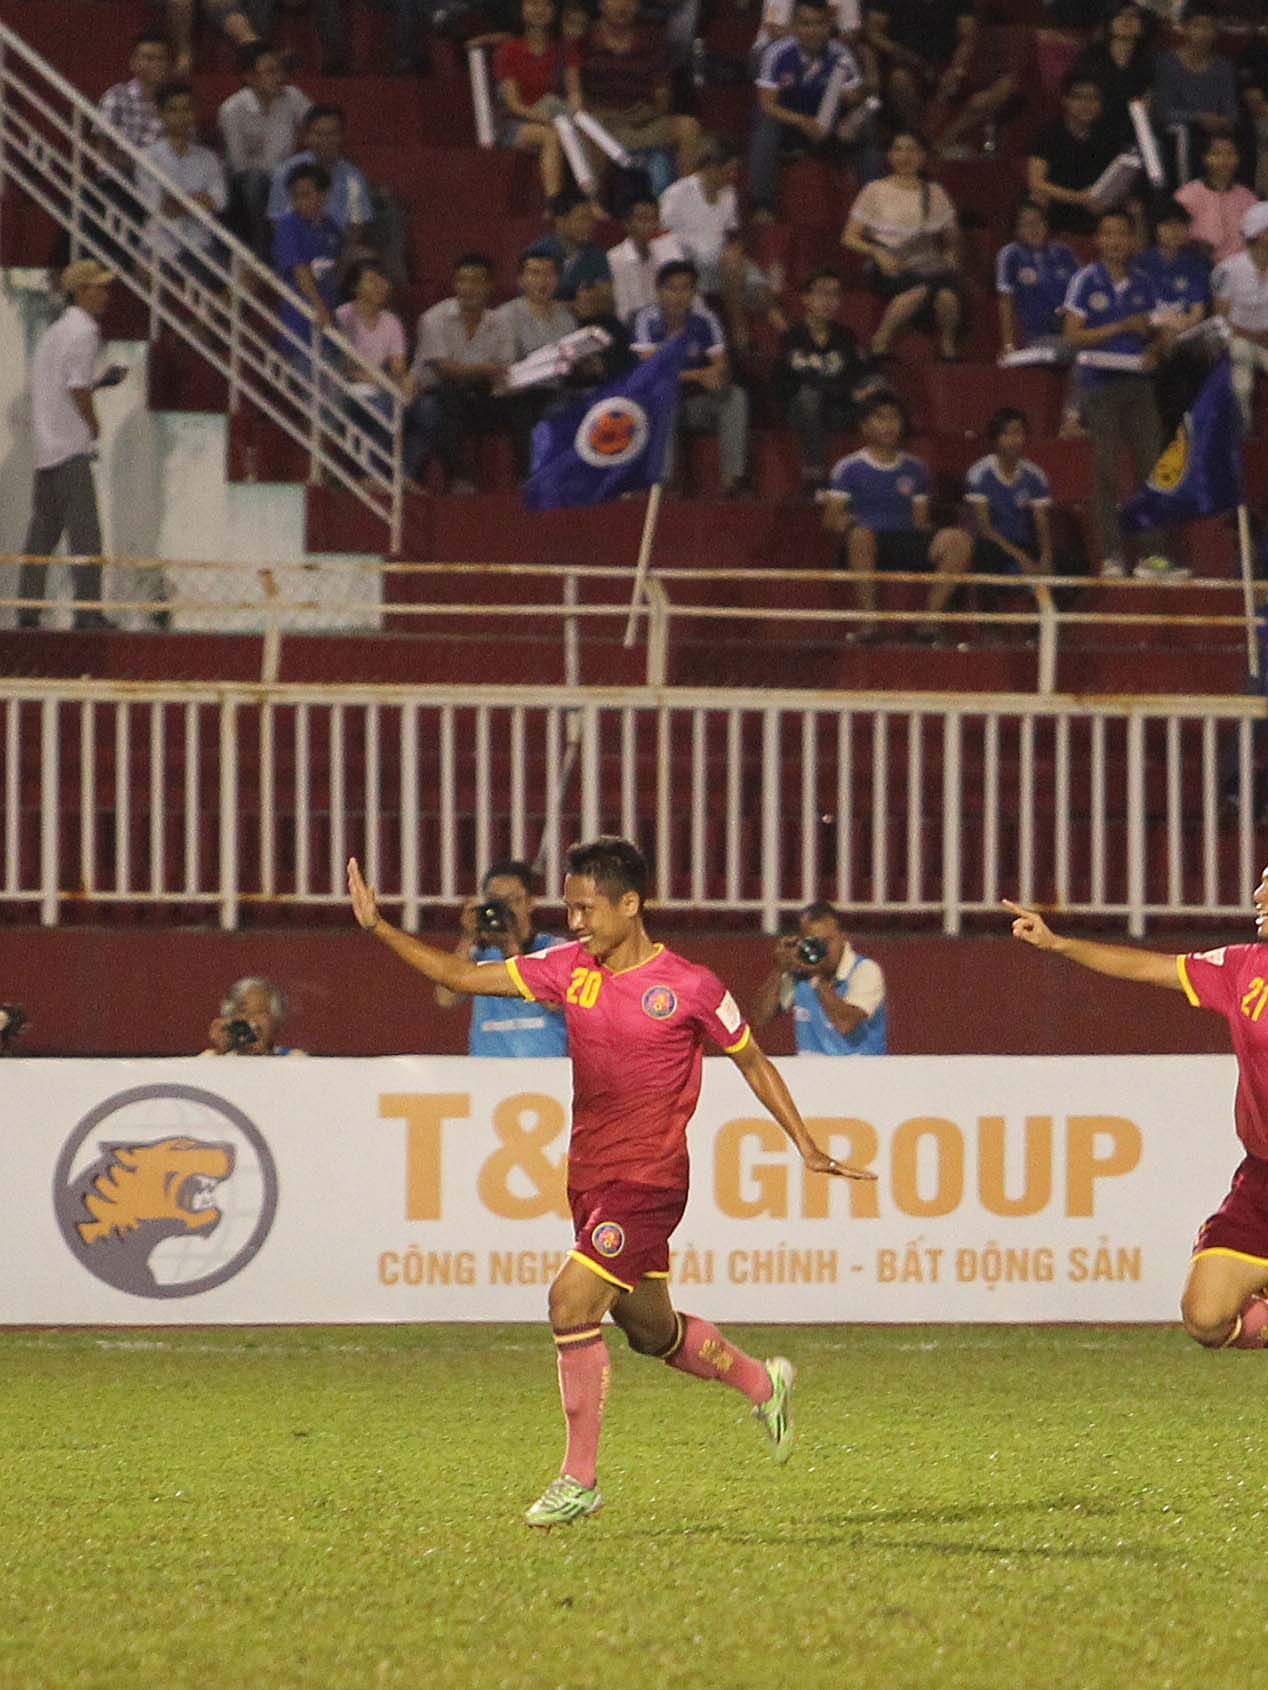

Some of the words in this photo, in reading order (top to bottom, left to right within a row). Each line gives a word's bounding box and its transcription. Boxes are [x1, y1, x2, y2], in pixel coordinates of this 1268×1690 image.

[566, 967, 603, 1009] 20
[713, 1115, 1143, 1220] GROUP
[377, 1244, 477, 1285] CÔNG
[488, 1249, 566, 1286] NGH
[727, 1240, 838, 1285] CHÍNH
[876, 1233, 943, 1284] BẤT
[955, 1240, 1055, 1290] ĐỘNG
[1067, 1235, 1142, 1283] SẢN
